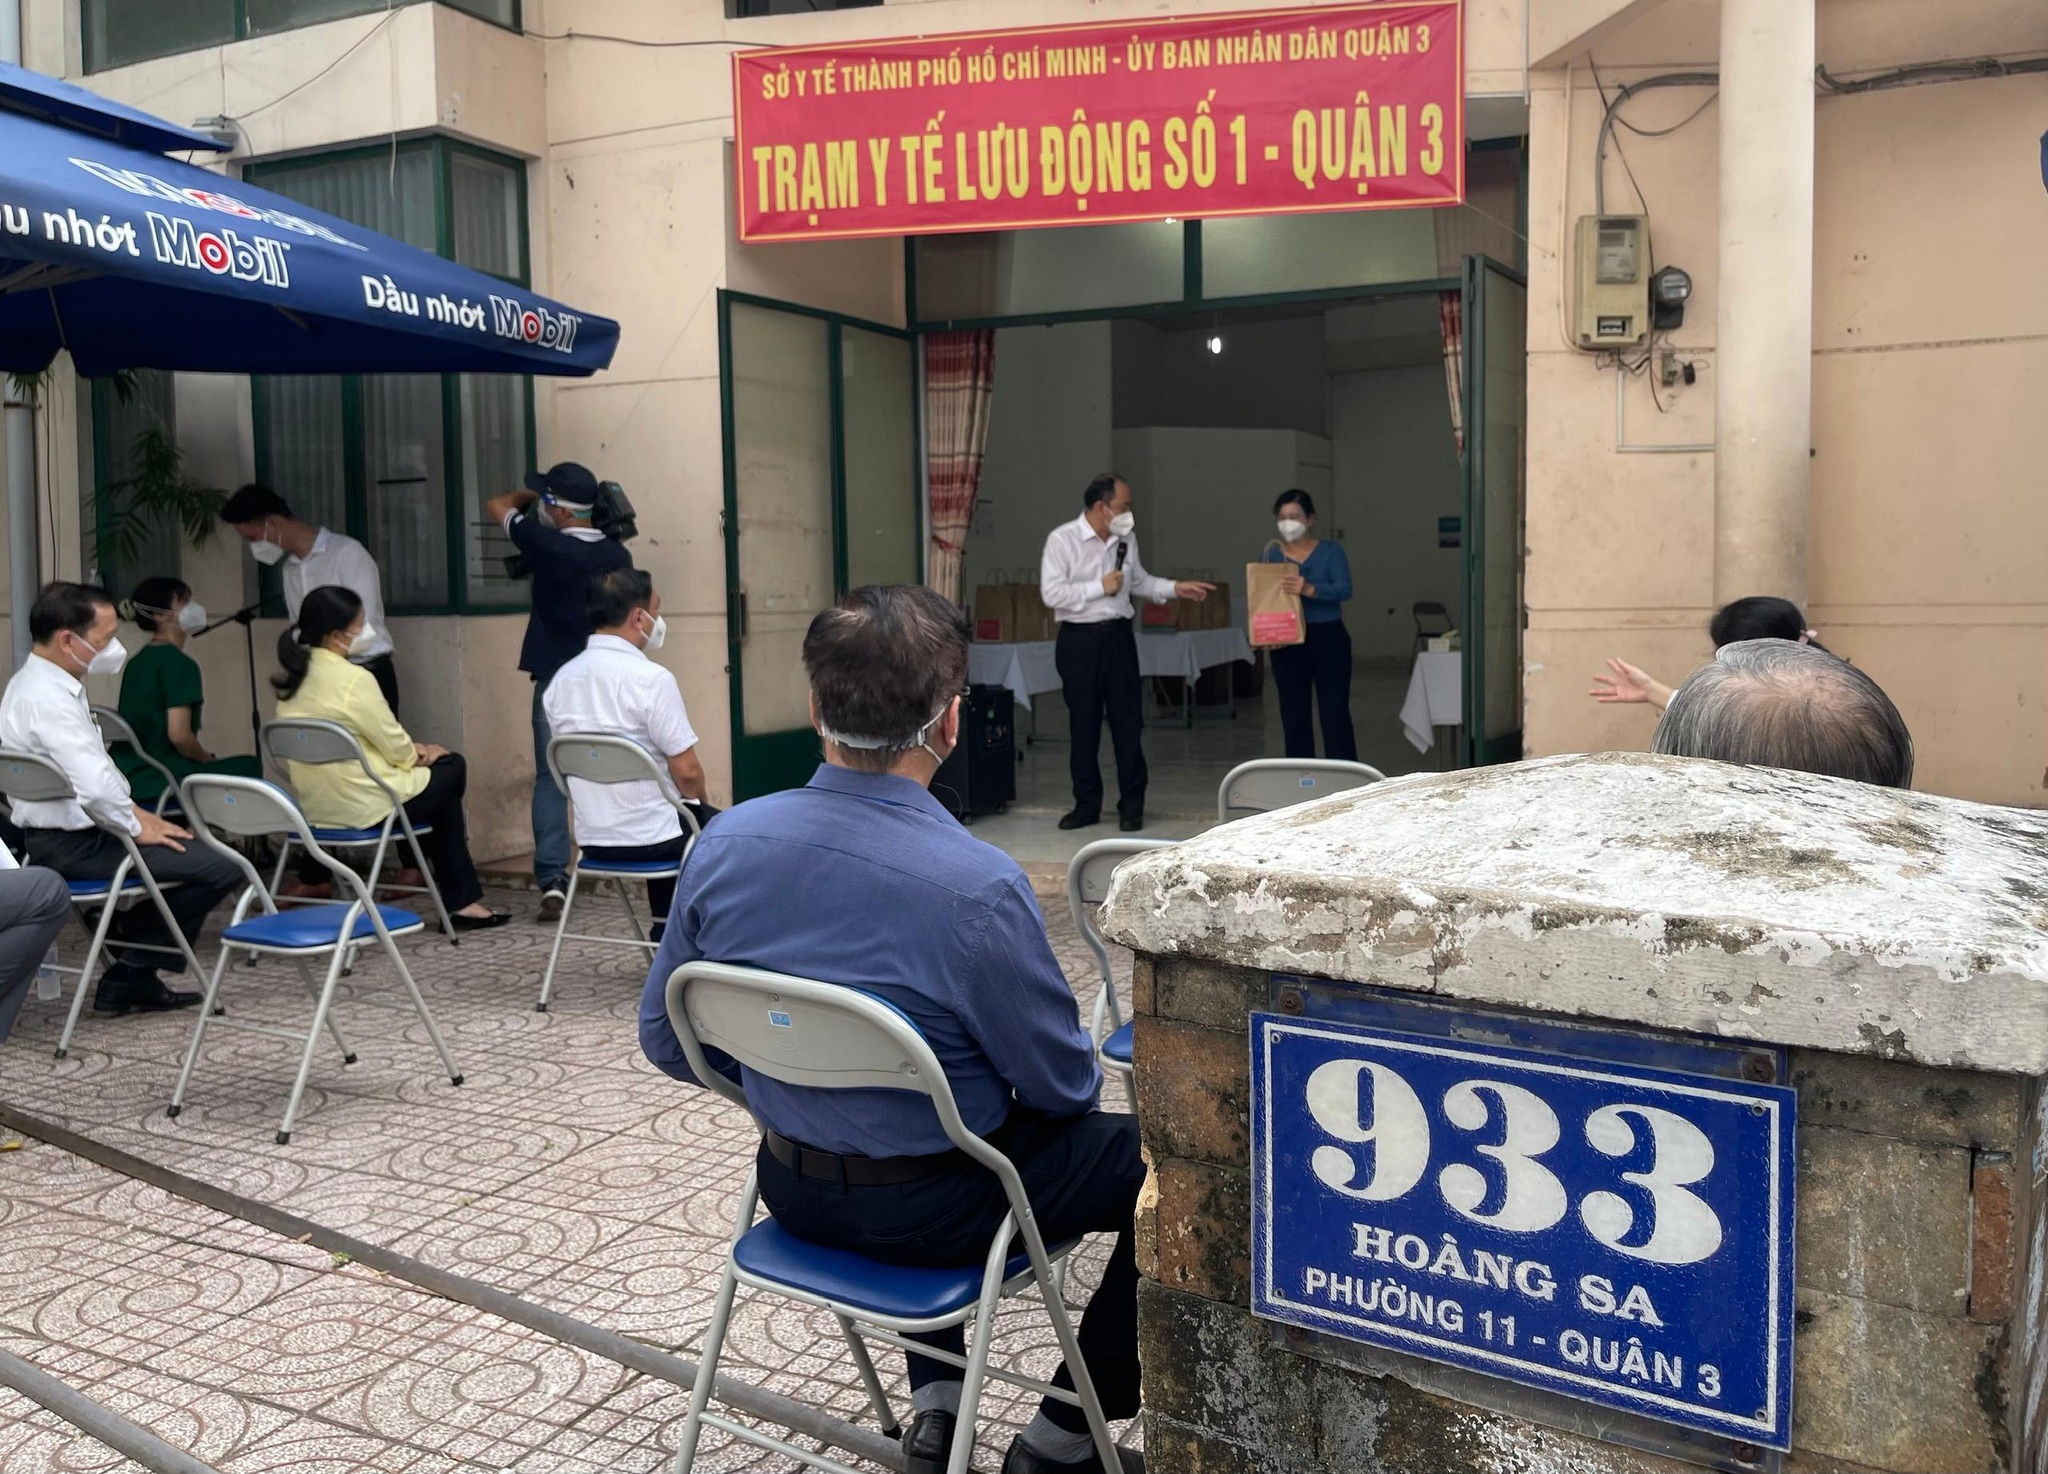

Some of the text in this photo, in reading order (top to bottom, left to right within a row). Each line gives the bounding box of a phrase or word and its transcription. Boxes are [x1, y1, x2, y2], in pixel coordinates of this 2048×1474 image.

[763, 63, 789, 99] SỞ
[795, 70, 806, 96] Y
[812, 58, 837, 95] TẾ
[841, 58, 912, 92] THÀNH
[917, 47, 962, 86] PHỐ
[967, 45, 997, 83] HỒ
[1002, 45, 1040, 81] CHÍ
[1046, 46, 1107, 77] MINH
[1127, 34, 1156, 72] ỦY
[1163, 39, 1210, 69] BAN
[1216, 29, 1282, 65] NHÂN
[1289, 26, 1338, 60] DÂN
[1344, 21, 1410, 61] QUẬN
[1416, 25, 1430, 53] 3
[753, 88, 1444, 226] TRẠM Y TẾ LƯU ĐỘNG SỐ 1 - QUẬN 3
[43, 208, 140, 257] nhớt
[145, 211, 291, 288] Mobil
[361, 274, 582, 354] Dầu nhớt Mobil
[1306, 1059, 1723, 1264] 933
[1352, 1221, 1664, 1327] HOÀNG SA
[1306, 1267, 1722, 1398] PHƯỜNG 11 - QUẬN 3
